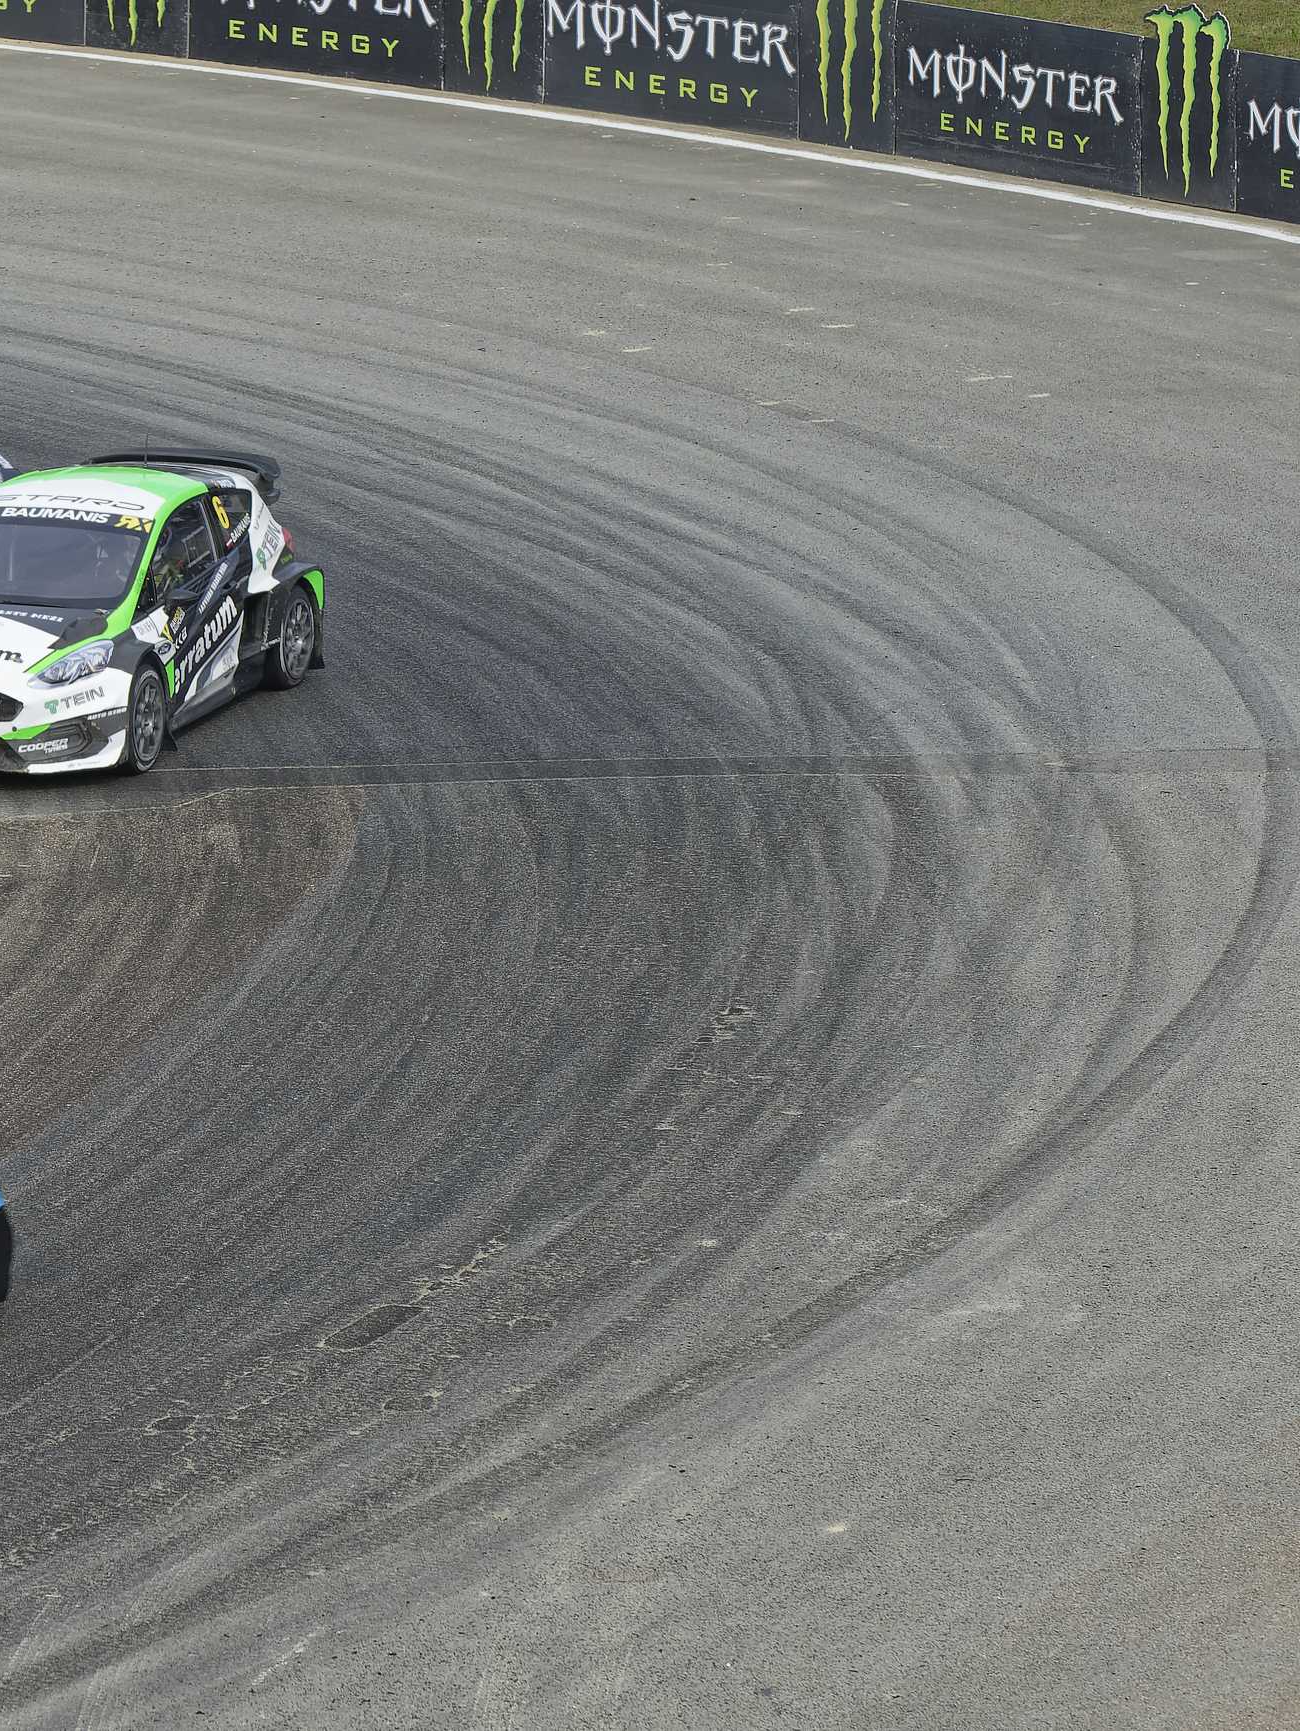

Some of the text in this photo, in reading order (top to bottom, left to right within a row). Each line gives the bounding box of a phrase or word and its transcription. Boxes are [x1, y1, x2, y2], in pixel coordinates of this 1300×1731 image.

[228, 19, 400, 58] ENERGY
[584, 66, 759, 107] ENERGY
[907, 43, 1125, 127] MONSTER
[940, 112, 1091, 153] ENERGY
[1, 507, 111, 524] BAUMANIS
[211, 495, 230, 529] 6
[60, 686, 105, 709] TEIN
[18, 738, 69, 753] COOPER
